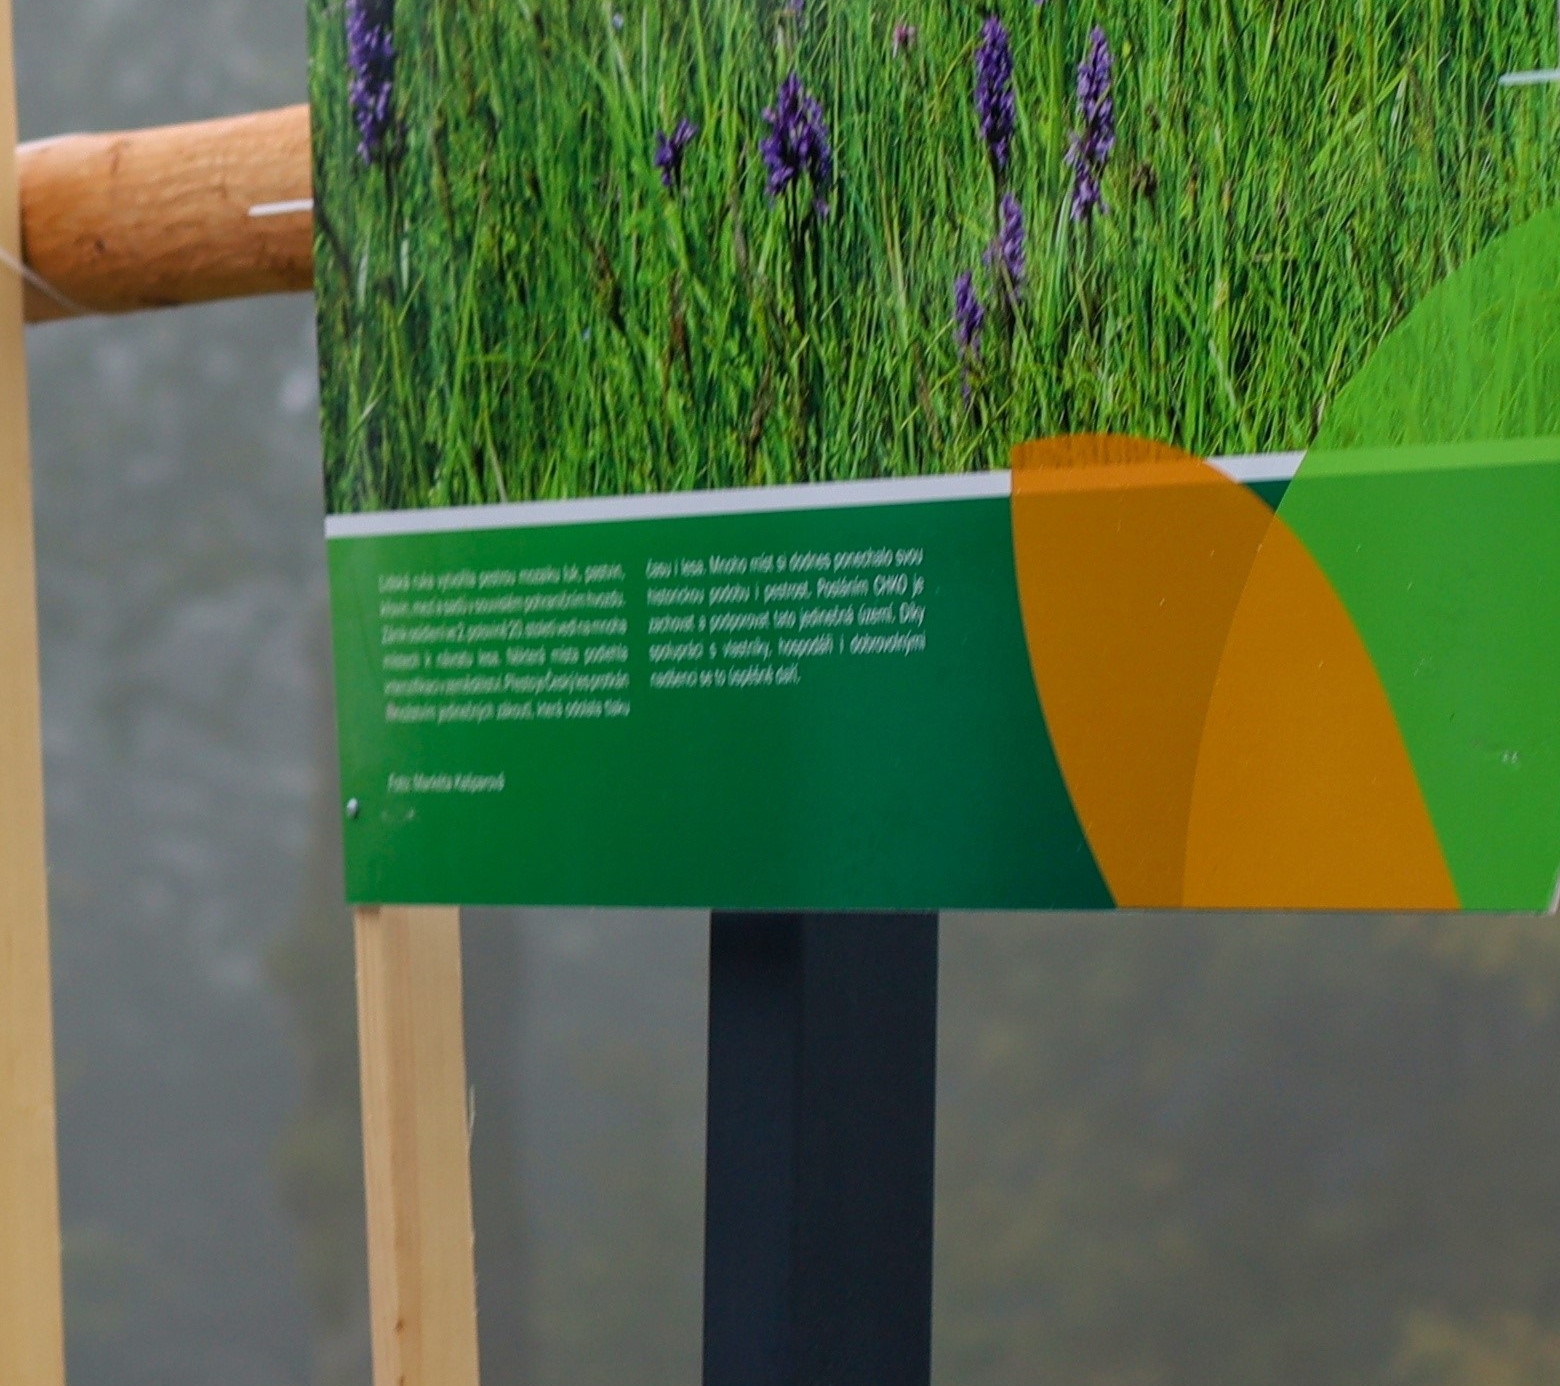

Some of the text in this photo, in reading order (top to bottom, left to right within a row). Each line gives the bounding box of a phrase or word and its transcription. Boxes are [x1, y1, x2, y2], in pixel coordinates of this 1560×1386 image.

[681, 560, 707, 576] lesa.
[709, 556, 748, 574] Mnoho
[749, 554, 773, 572] míst
[776, 555, 787, 572] si
[789, 552, 831, 571] dodnes
[833, 548, 893, 571] ponechalo
[895, 549, 923, 566] svou
[647, 588, 704, 605] historickou
[709, 584, 750, 605] podobu
[764, 581, 811, 602] pestrost.
[817, 577, 868, 598] Posláním
[873, 574, 907, 595] CHKO
[912, 577, 924, 598] je
[648, 615, 694, 633] zachovat
[710, 612, 769, 633] podporovat
[900, 602, 925, 626] Díky
[850, 631, 925, 655] dobrovolnými
[700, 671, 713, 686] se
[714, 669, 726, 686] to
